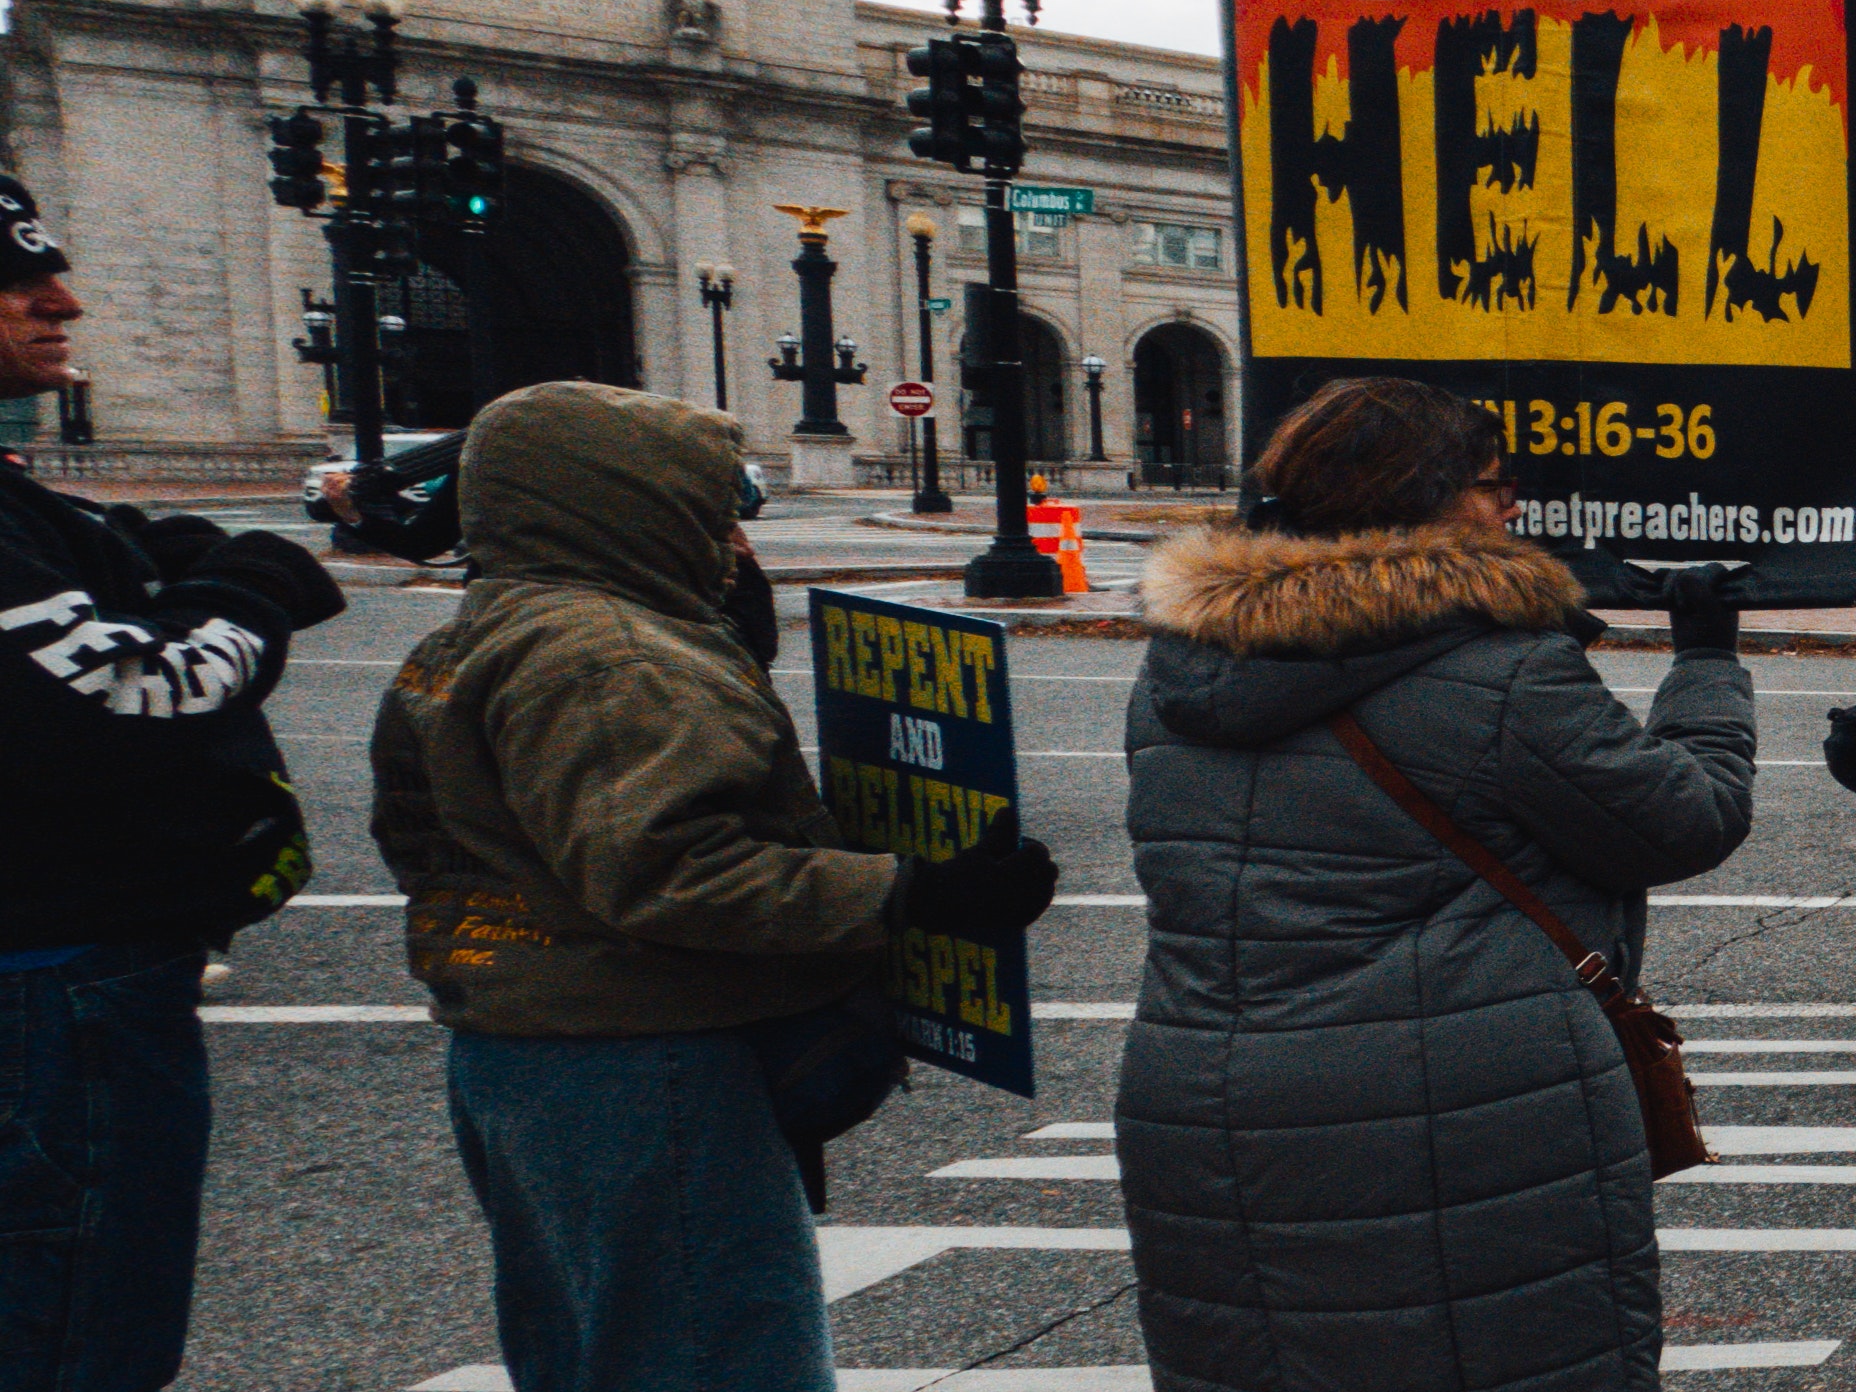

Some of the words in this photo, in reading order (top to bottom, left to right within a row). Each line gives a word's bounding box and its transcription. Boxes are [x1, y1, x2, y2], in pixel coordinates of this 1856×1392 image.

[1268, 11, 1820, 324] HELL
[1528, 398, 1717, 460] 3:16-36
[822, 605, 995, 725] REPENT
[889, 712, 945, 771] AND
